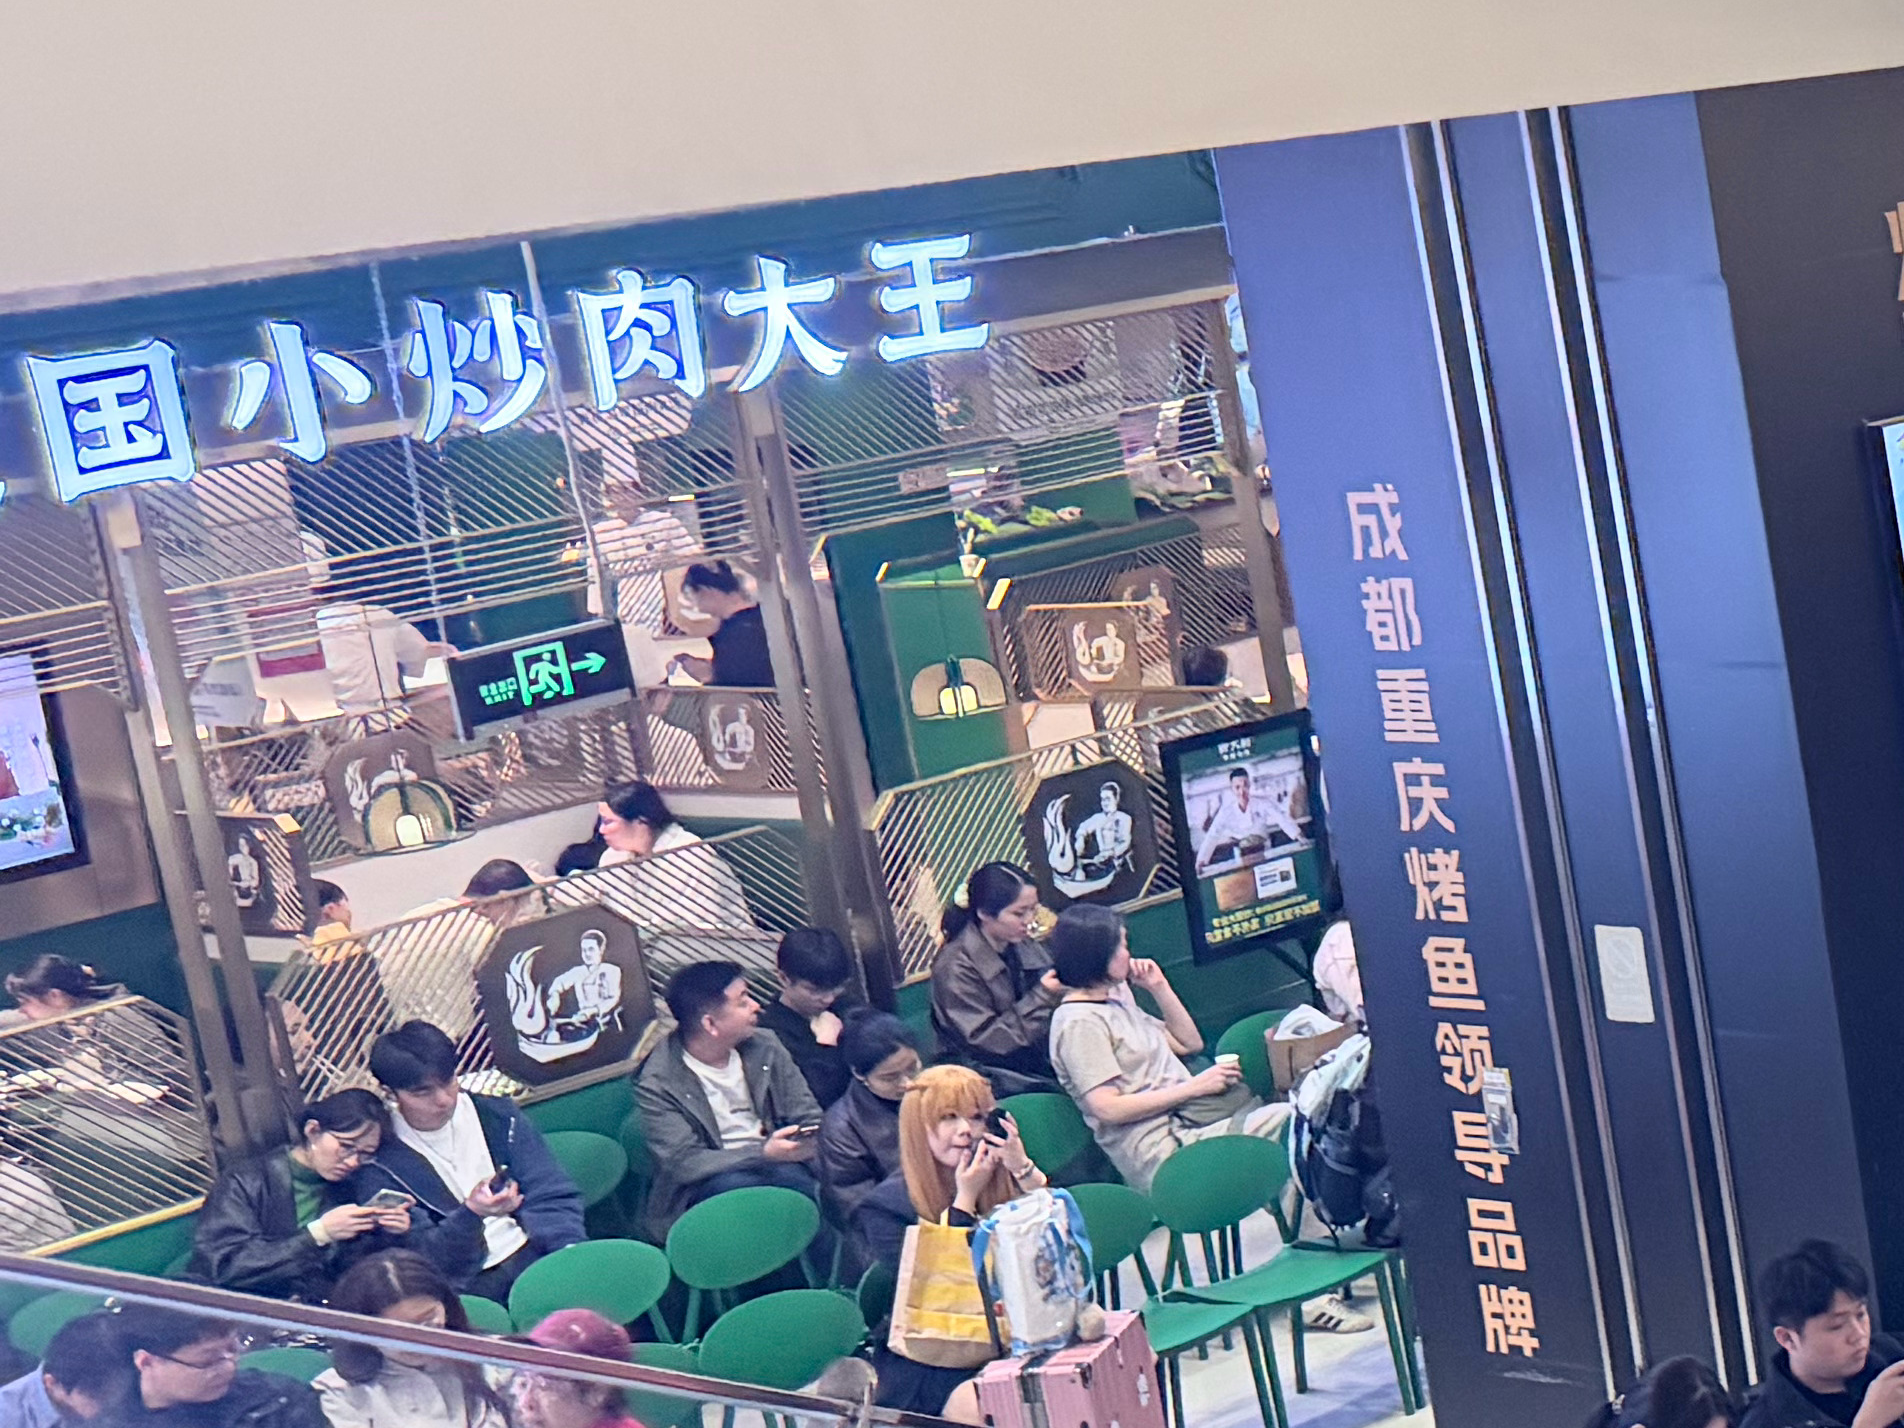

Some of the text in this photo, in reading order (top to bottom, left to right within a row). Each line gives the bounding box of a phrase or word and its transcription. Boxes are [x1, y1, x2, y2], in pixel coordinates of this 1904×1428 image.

[0, 232, 990, 502] 国小炒肉大王
[1346, 483, 1541, 1359] 成都重庆烤鱼领导品牌
